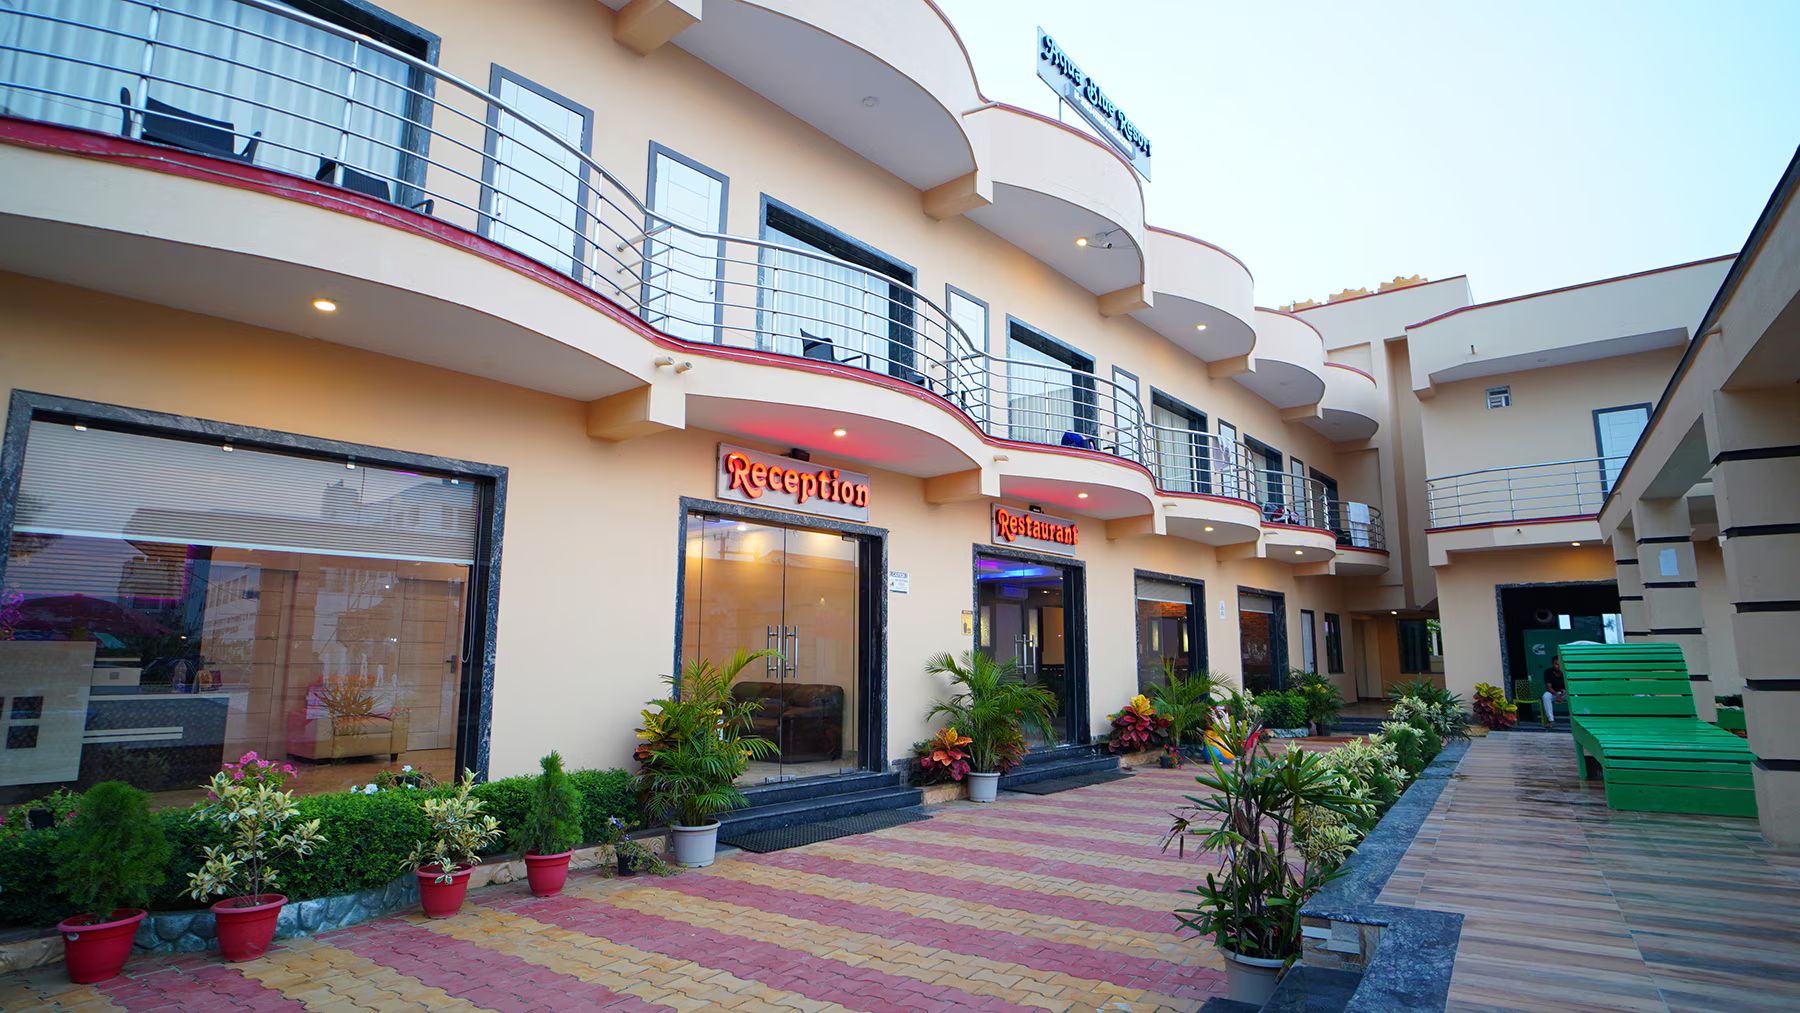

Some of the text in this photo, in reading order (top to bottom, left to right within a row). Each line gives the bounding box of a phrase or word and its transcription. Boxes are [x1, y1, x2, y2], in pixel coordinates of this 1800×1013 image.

[1041, 34, 1081, 87] Aqua
[1083, 77, 1114, 118] Blue
[1115, 109, 1152, 157] Resort
[724, 451, 870, 508] Reception
[995, 508, 1079, 545] Restaurant
